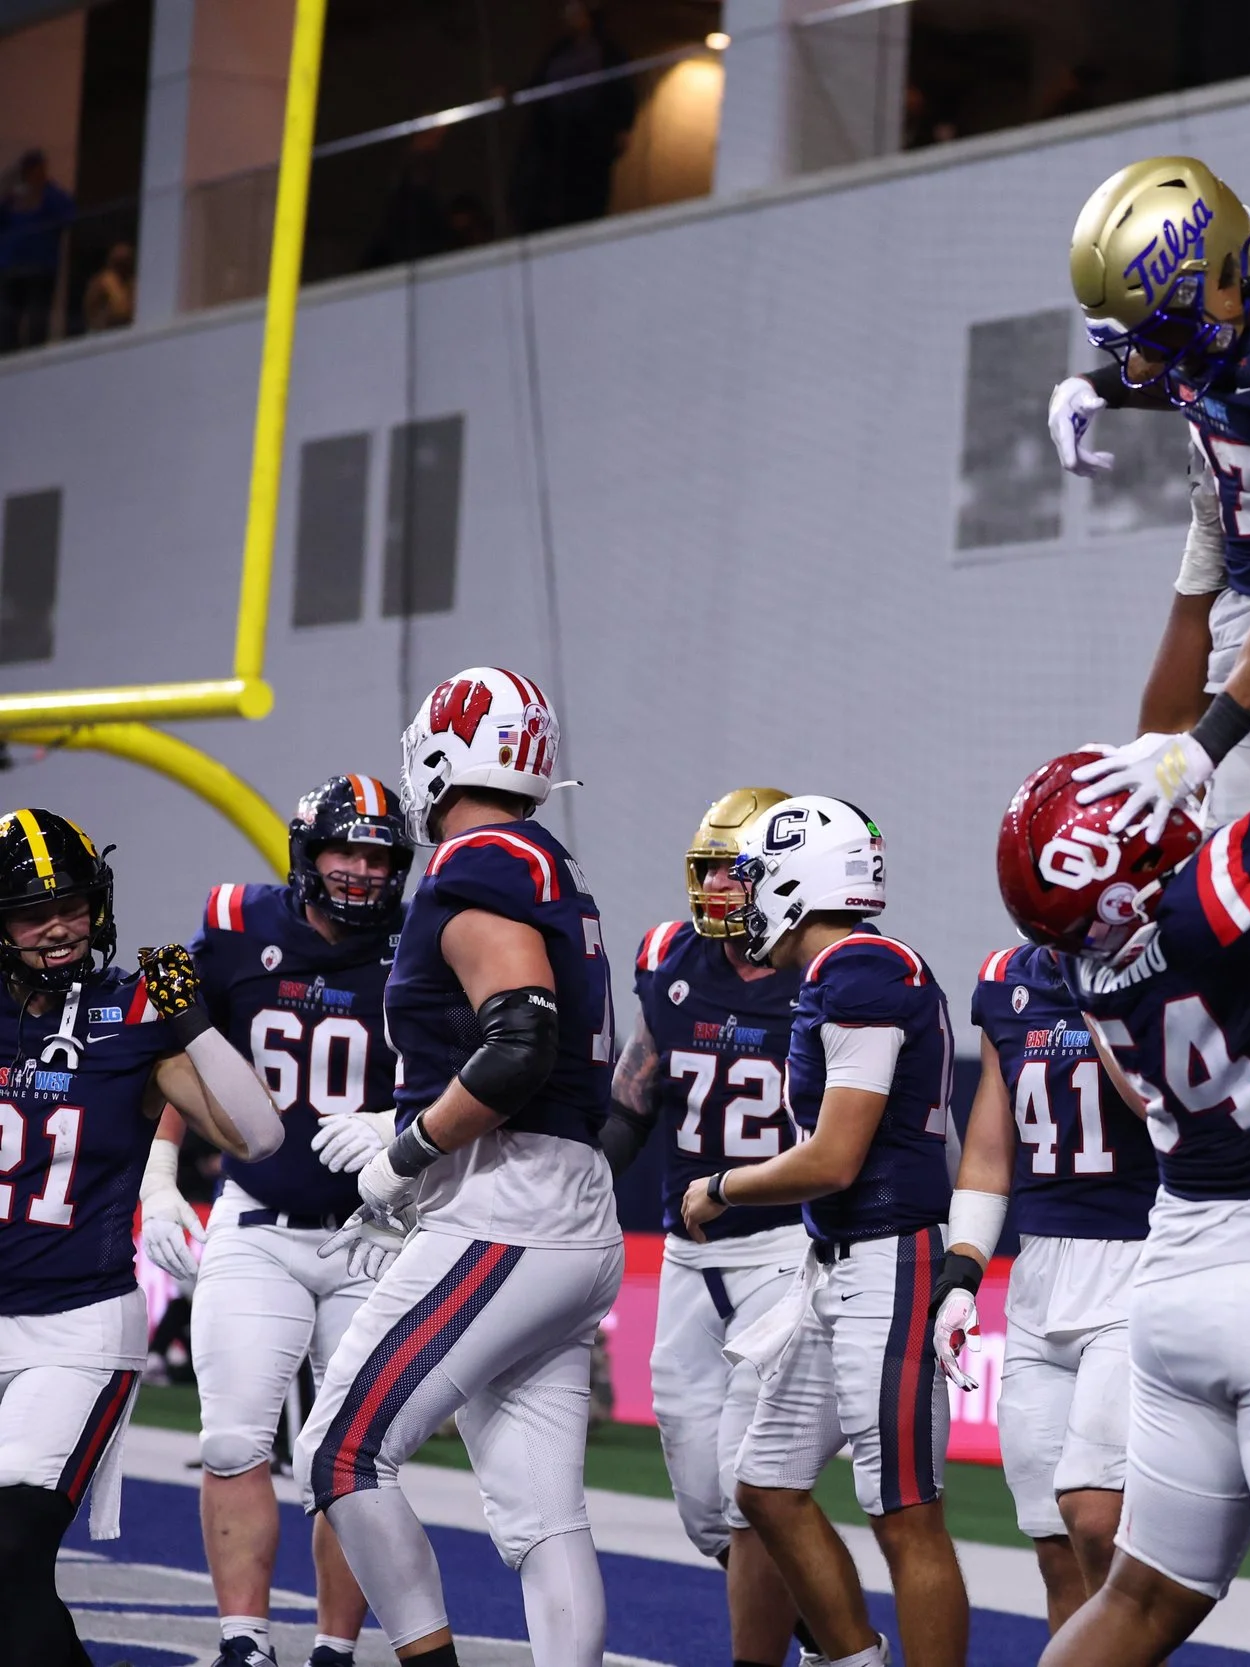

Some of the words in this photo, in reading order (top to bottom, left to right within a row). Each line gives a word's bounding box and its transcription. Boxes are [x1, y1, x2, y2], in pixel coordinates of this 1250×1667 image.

[1123, 197, 1213, 306] Tulsa
[430, 680, 493, 748] W
[762, 808, 809, 857] C
[1038, 826, 1121, 891] OU
[251, 1008, 370, 1116] 60
[1024, 1049, 1056, 1057] SHRINE
[1025, 1030, 1050, 1048] EAST
[1063, 1030, 1091, 1048] WEST
[34, 1092, 67, 1101] BOWL
[35, 1071, 73, 1092] WEST
[669, 1049, 783, 1159] 72
[1014, 1060, 1115, 1175] 41
